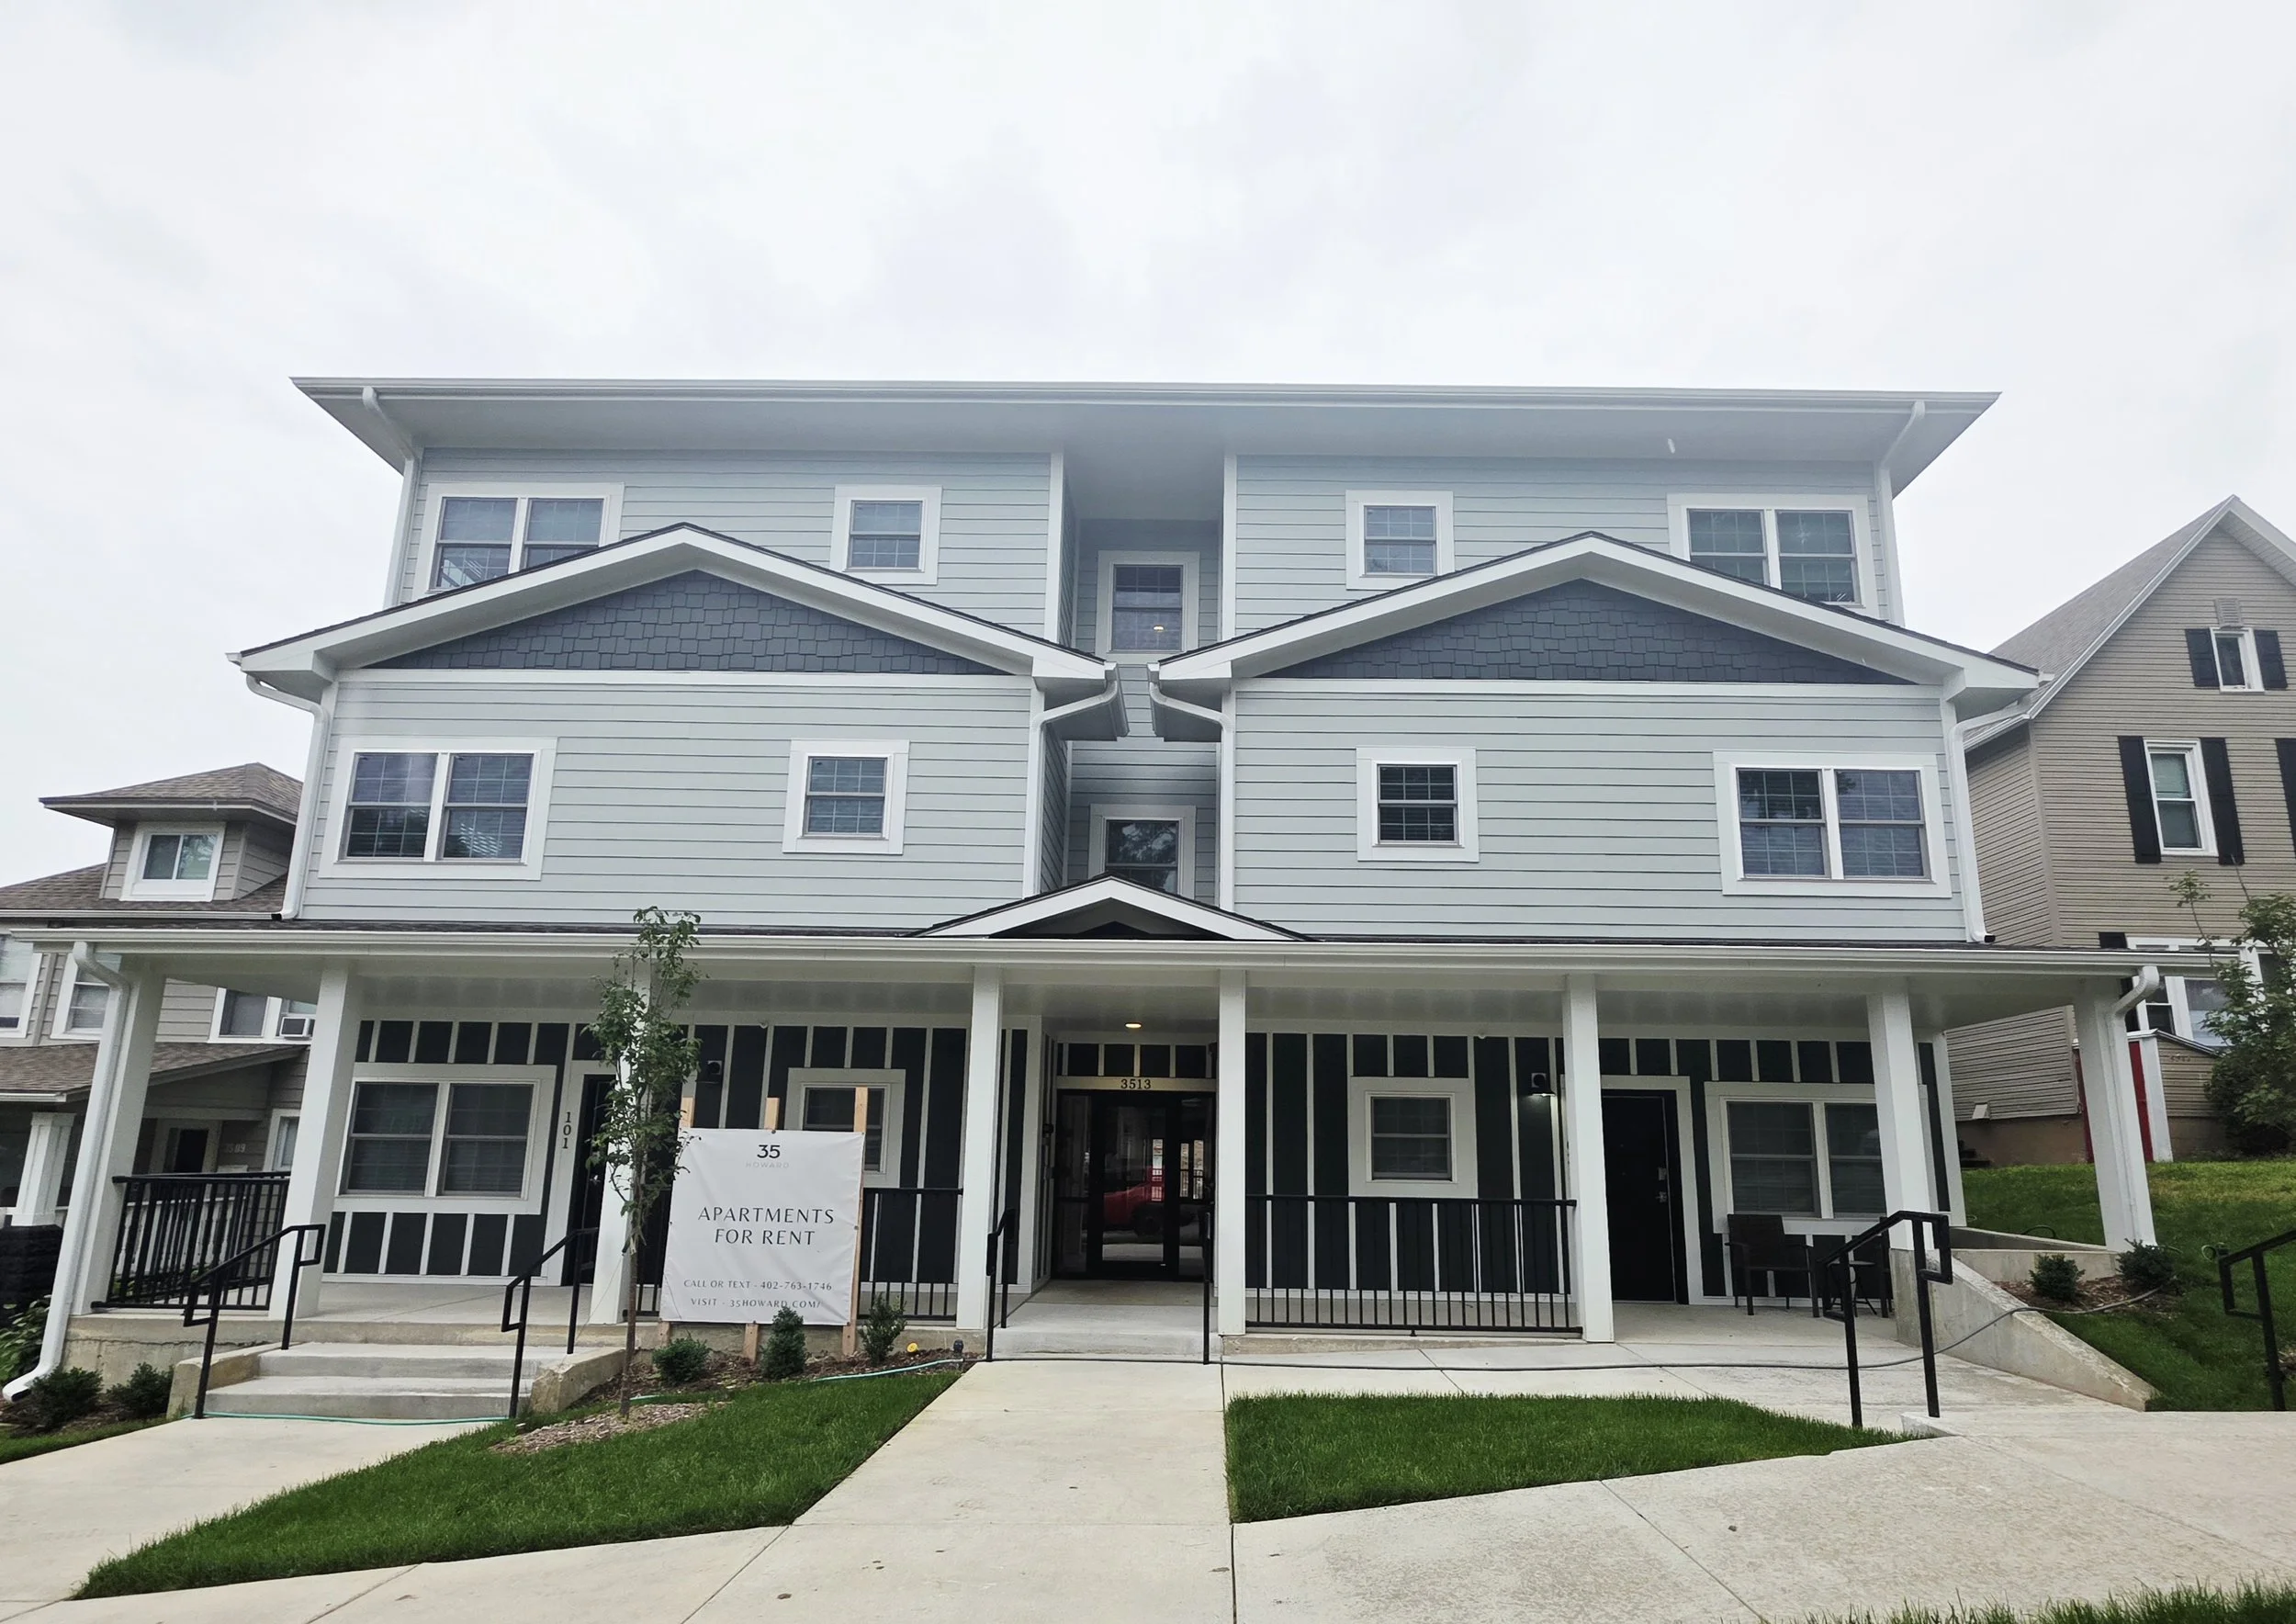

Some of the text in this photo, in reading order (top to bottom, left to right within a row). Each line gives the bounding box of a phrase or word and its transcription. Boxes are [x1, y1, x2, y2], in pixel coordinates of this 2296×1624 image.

[1120, 1078, 1152, 1089] 3513
[562, 1111, 571, 1149] 101
[757, 1144, 781, 1158] 35
[697, 1206, 834, 1224] APARTMENTS
[715, 1228, 816, 1246] FOR RENT
[683, 1280, 706, 1288] CALL
[710, 1280, 724, 1288] OR
[728, 1280, 750, 1289] TEXT
[760, 1280, 832, 1291] 402-763-1746
[691, 1297, 717, 1306] VISIT
[730, 1299, 821, 1309] 35HOWARDCOM/
